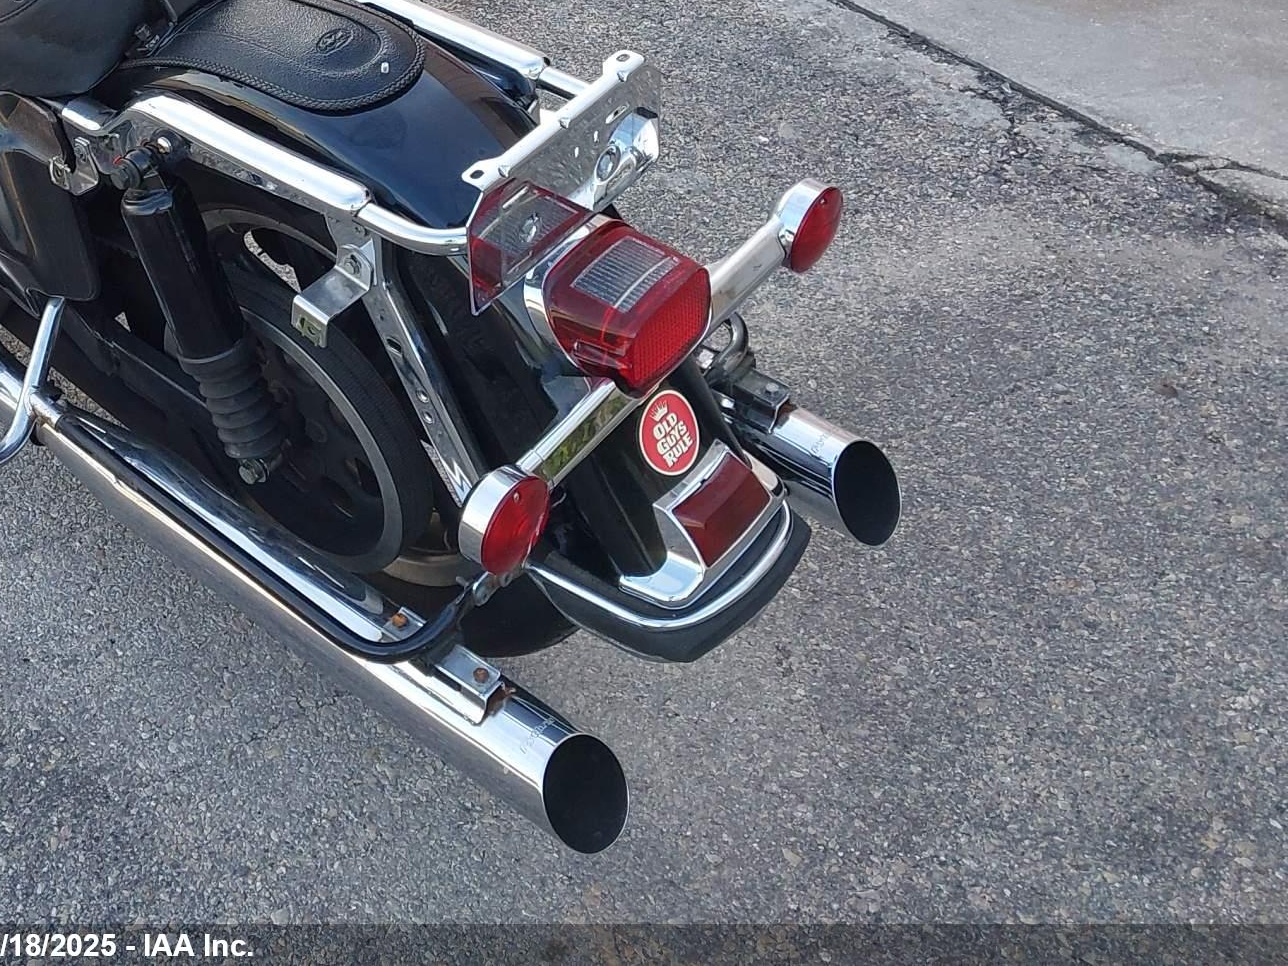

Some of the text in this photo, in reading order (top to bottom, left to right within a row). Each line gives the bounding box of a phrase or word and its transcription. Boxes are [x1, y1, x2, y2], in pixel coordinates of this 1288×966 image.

[653, 412, 678, 440] OLD
[656, 420, 688, 455] GUYS
[662, 431, 694, 468] RULE
